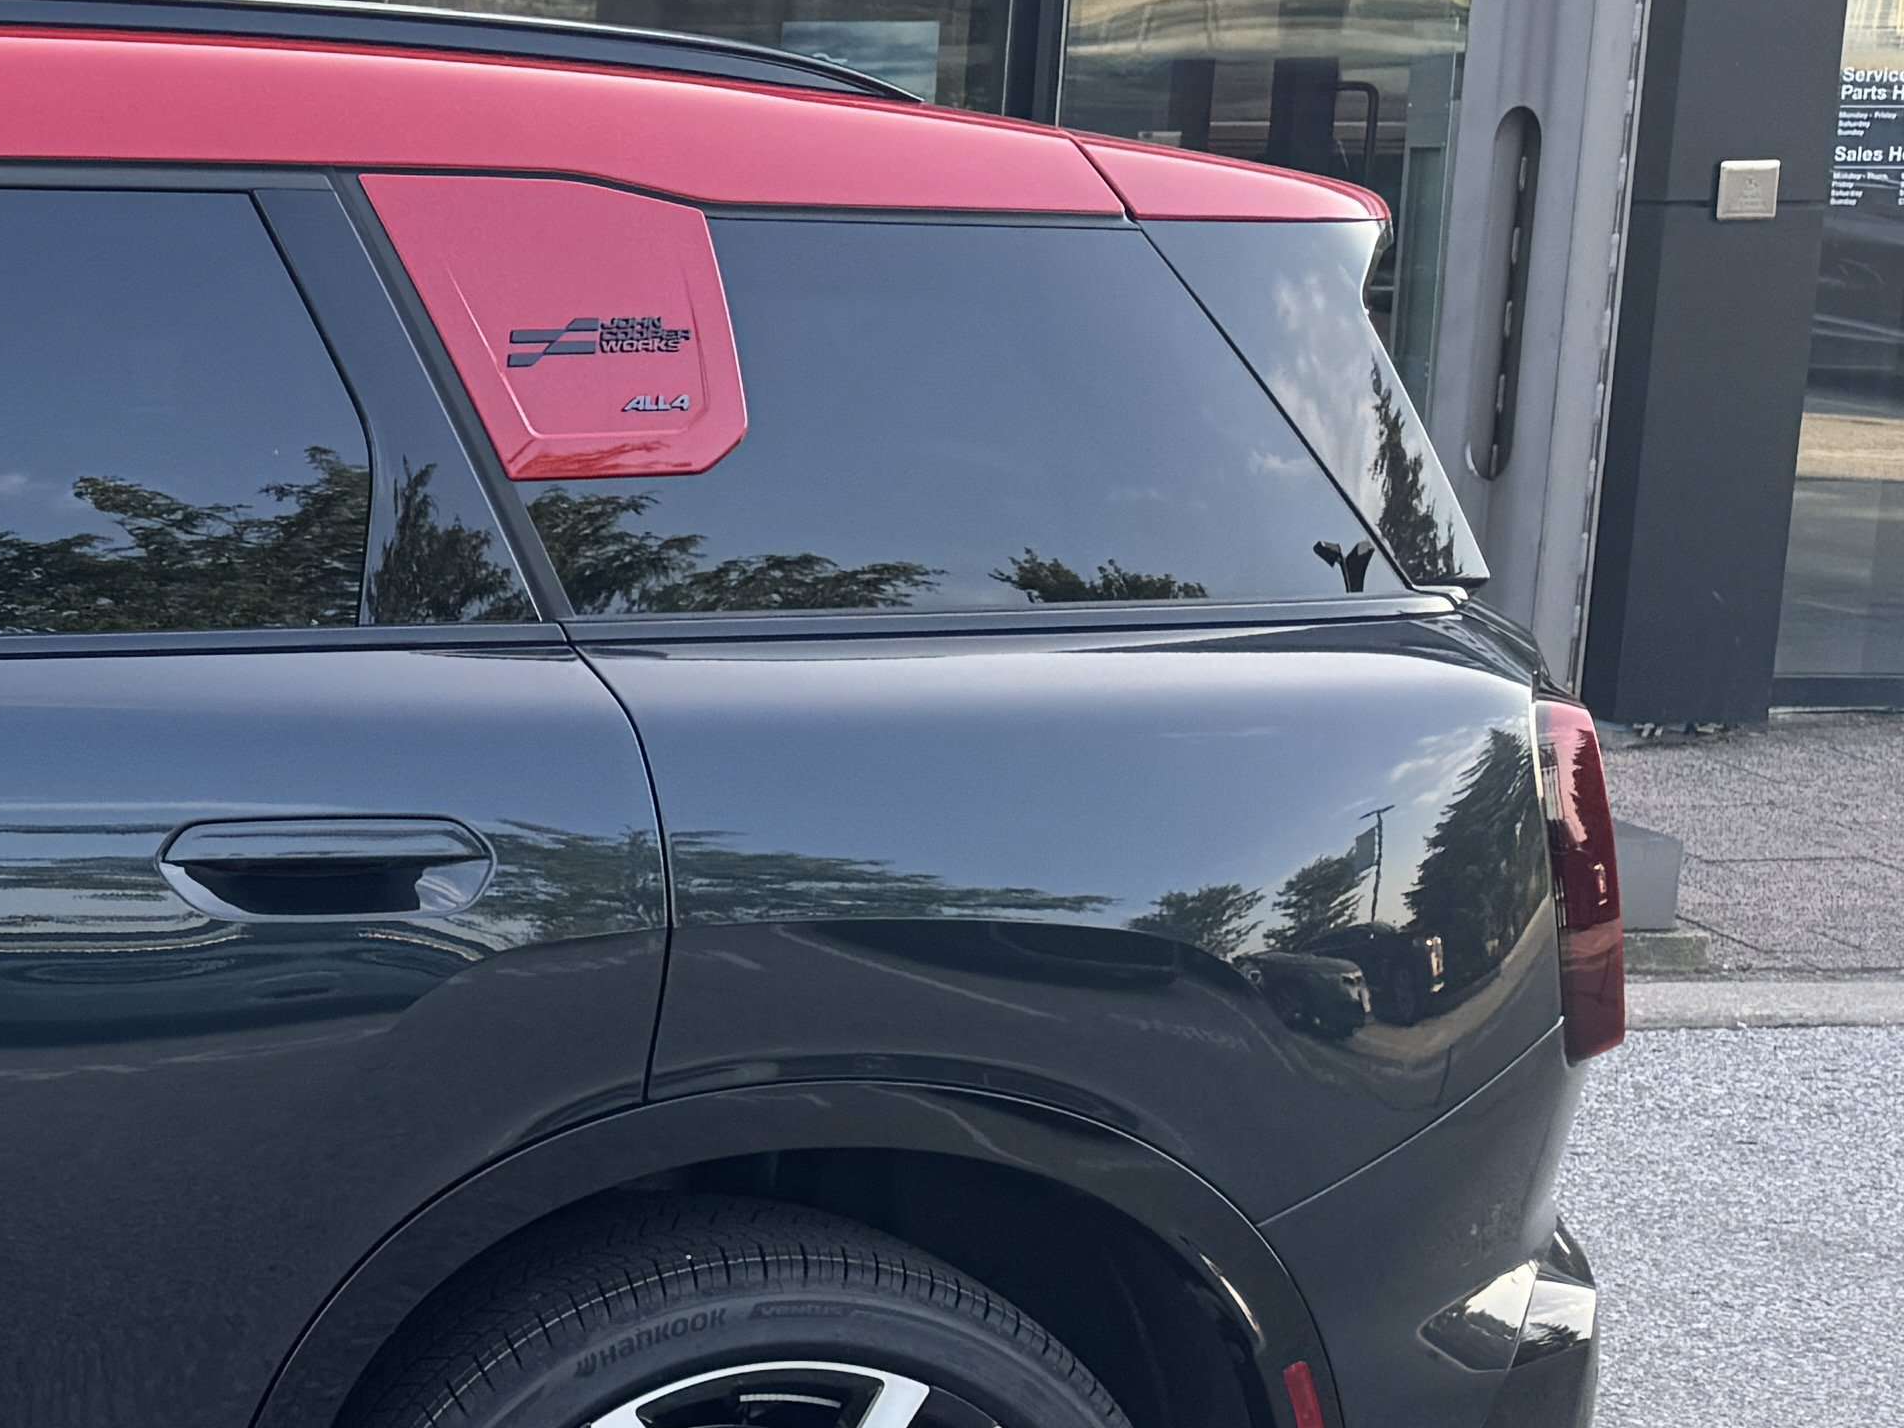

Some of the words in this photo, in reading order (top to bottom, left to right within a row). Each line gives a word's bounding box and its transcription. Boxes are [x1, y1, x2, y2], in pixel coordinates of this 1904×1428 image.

[1841, 84, 1887, 100] Parts
[1834, 145, 1883, 162] Sales
[600, 316, 661, 329] JOHN
[600, 328, 690, 341] COOPER
[600, 339, 680, 353] WORKS
[621, 395, 690, 412] ALL4
